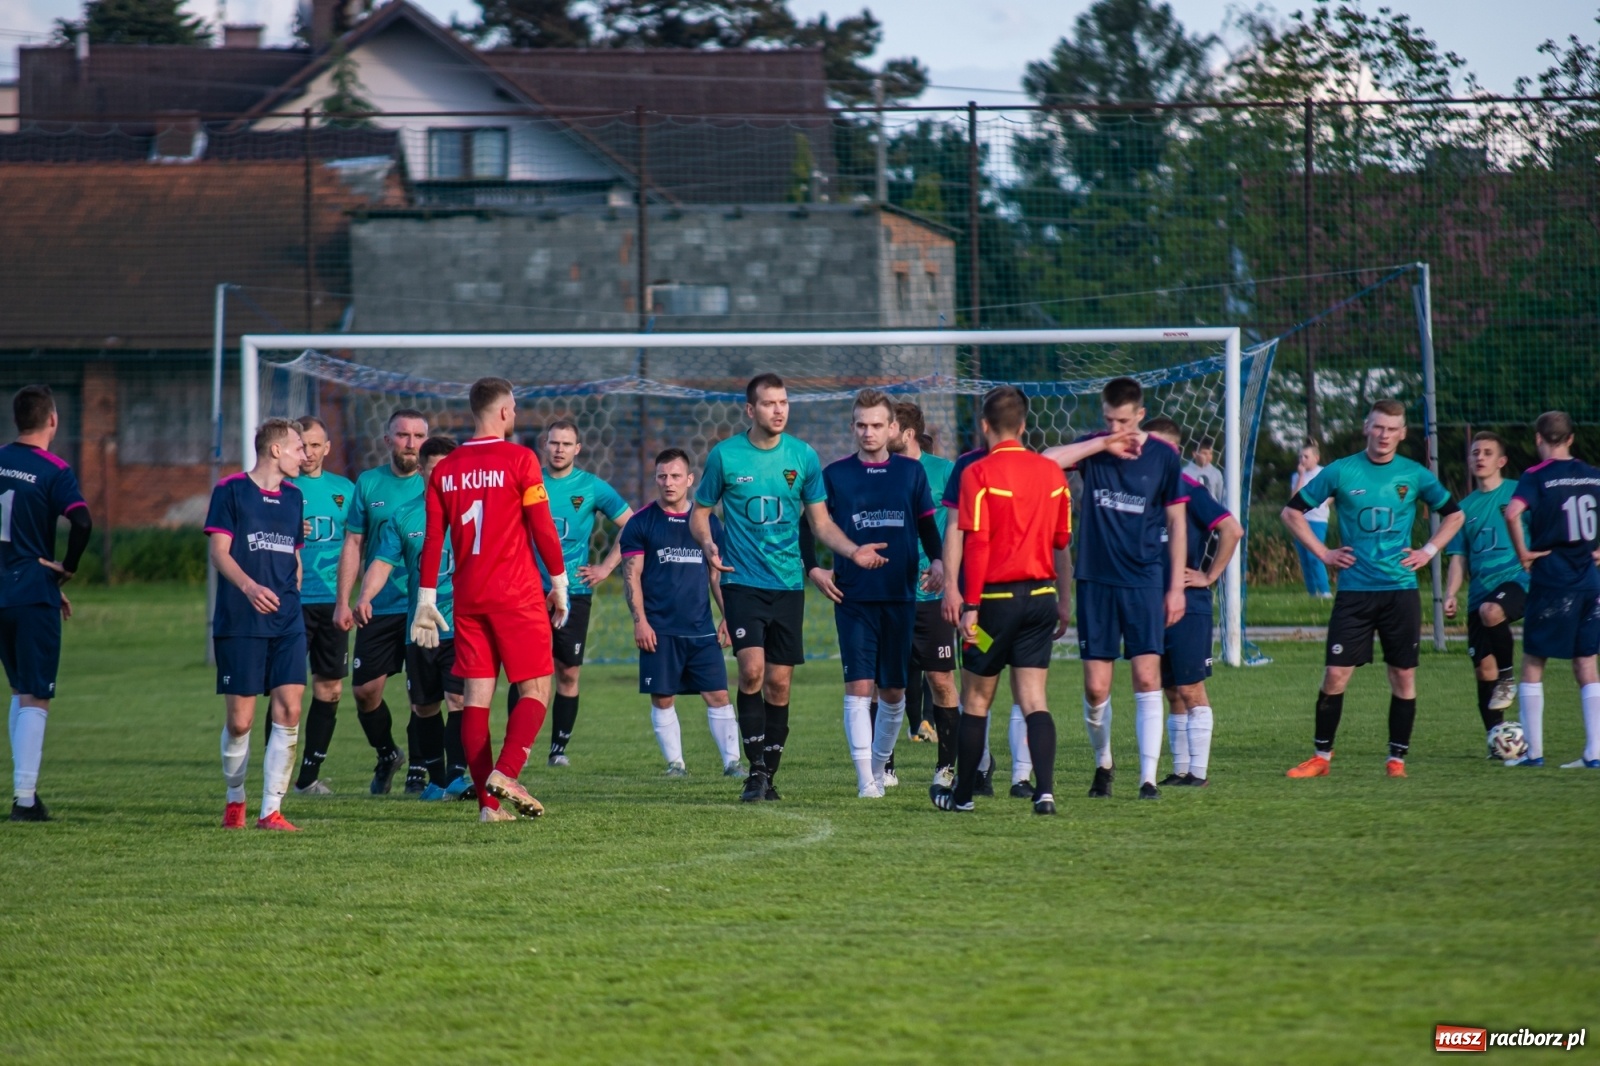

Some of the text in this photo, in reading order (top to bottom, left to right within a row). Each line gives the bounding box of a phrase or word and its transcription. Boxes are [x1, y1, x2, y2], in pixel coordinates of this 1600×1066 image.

[442, 469, 504, 493] M. KÜHN
[461, 500, 483, 555] 1
[1561, 494, 1597, 541] 16
[938, 645, 951, 658] 20
